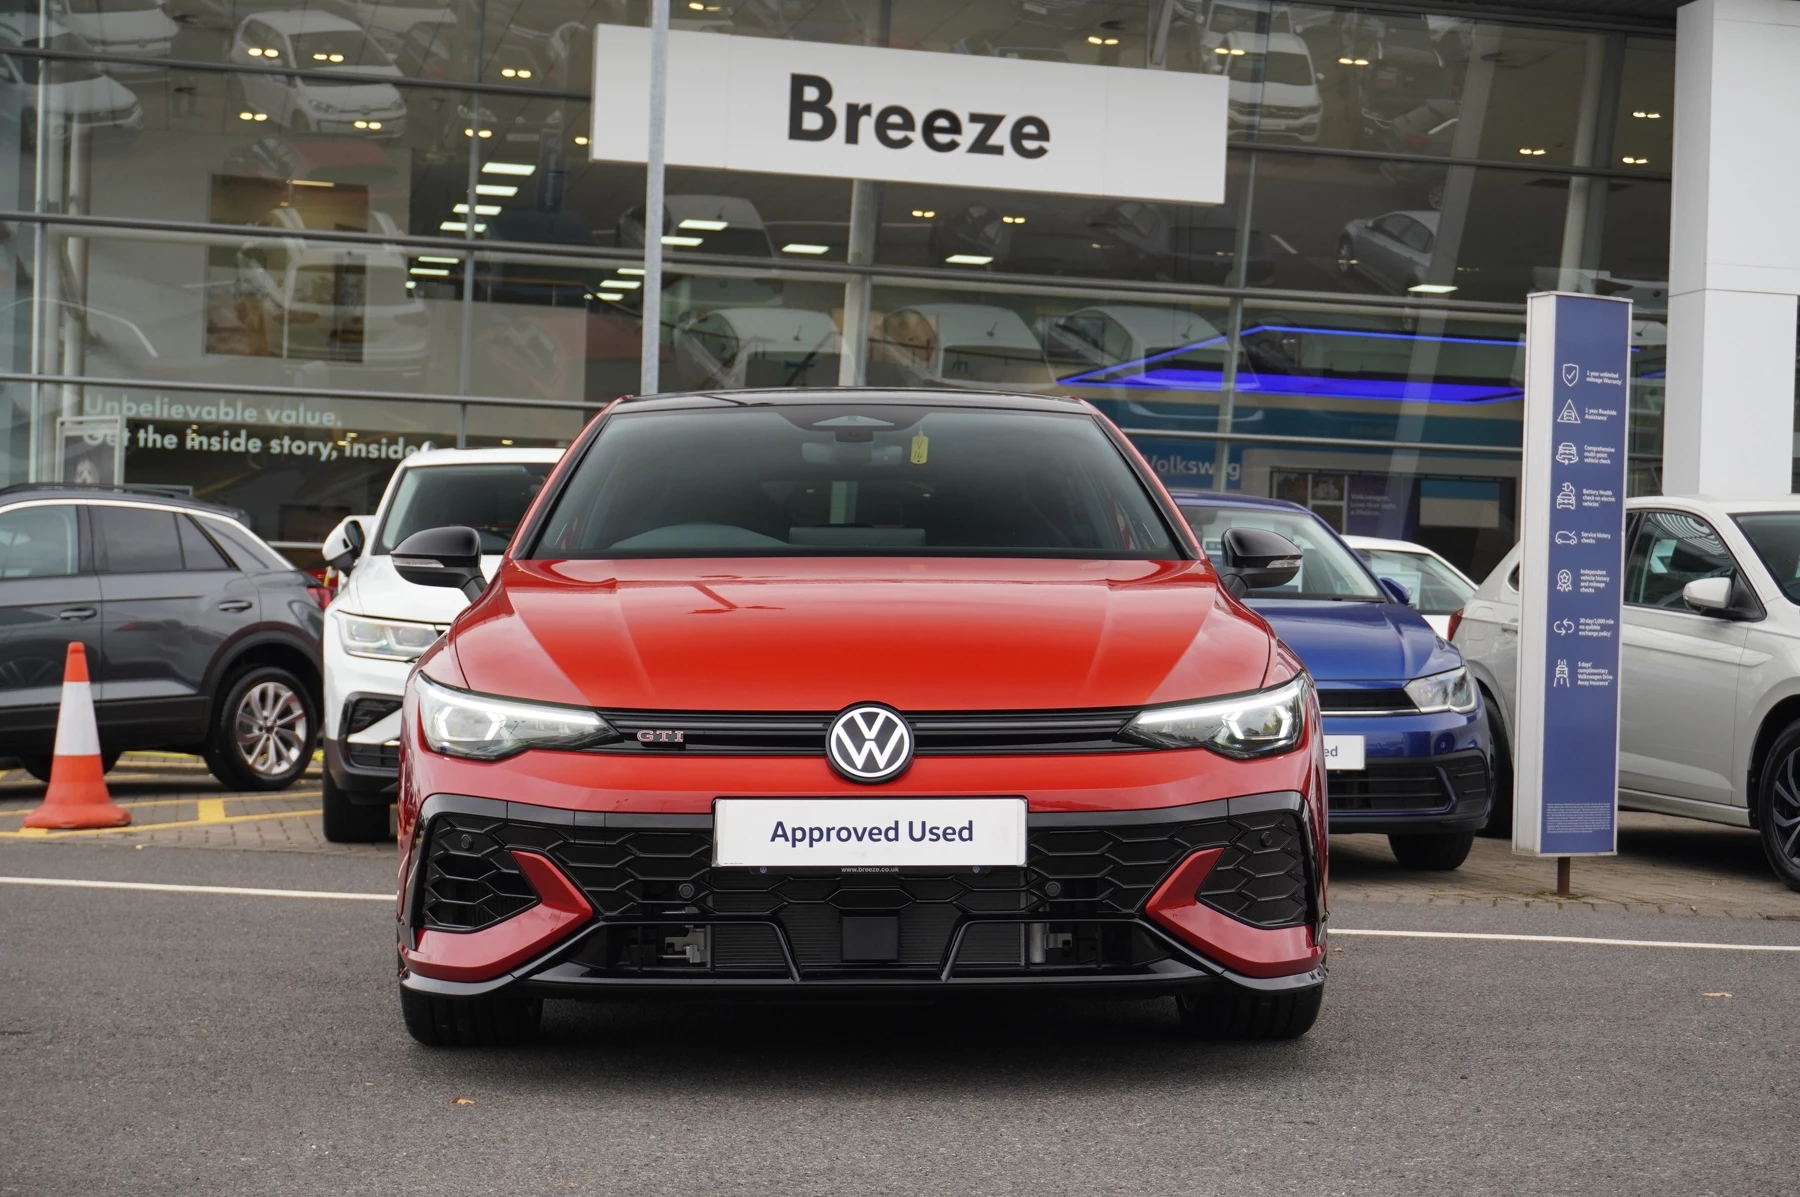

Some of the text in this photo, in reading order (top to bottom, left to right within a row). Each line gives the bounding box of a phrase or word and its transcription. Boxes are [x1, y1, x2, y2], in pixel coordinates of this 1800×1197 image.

[788, 72, 1050, 160] Breeze
[1586, 376, 1603, 384] mileage
[83, 393, 343, 427] Unbelievable value.
[1599, 408, 1617, 416] Roadside
[82, 422, 131, 447] Get
[137, 424, 178, 449] the
[186, 428, 262, 453] inside
[269, 434, 338, 462] story,
[1584, 444, 1615, 453] Comprehensive
[1577, 679, 1589, 687] Away
[636, 729, 684, 742] GTI
[770, 820, 974, 848] Approved Used
